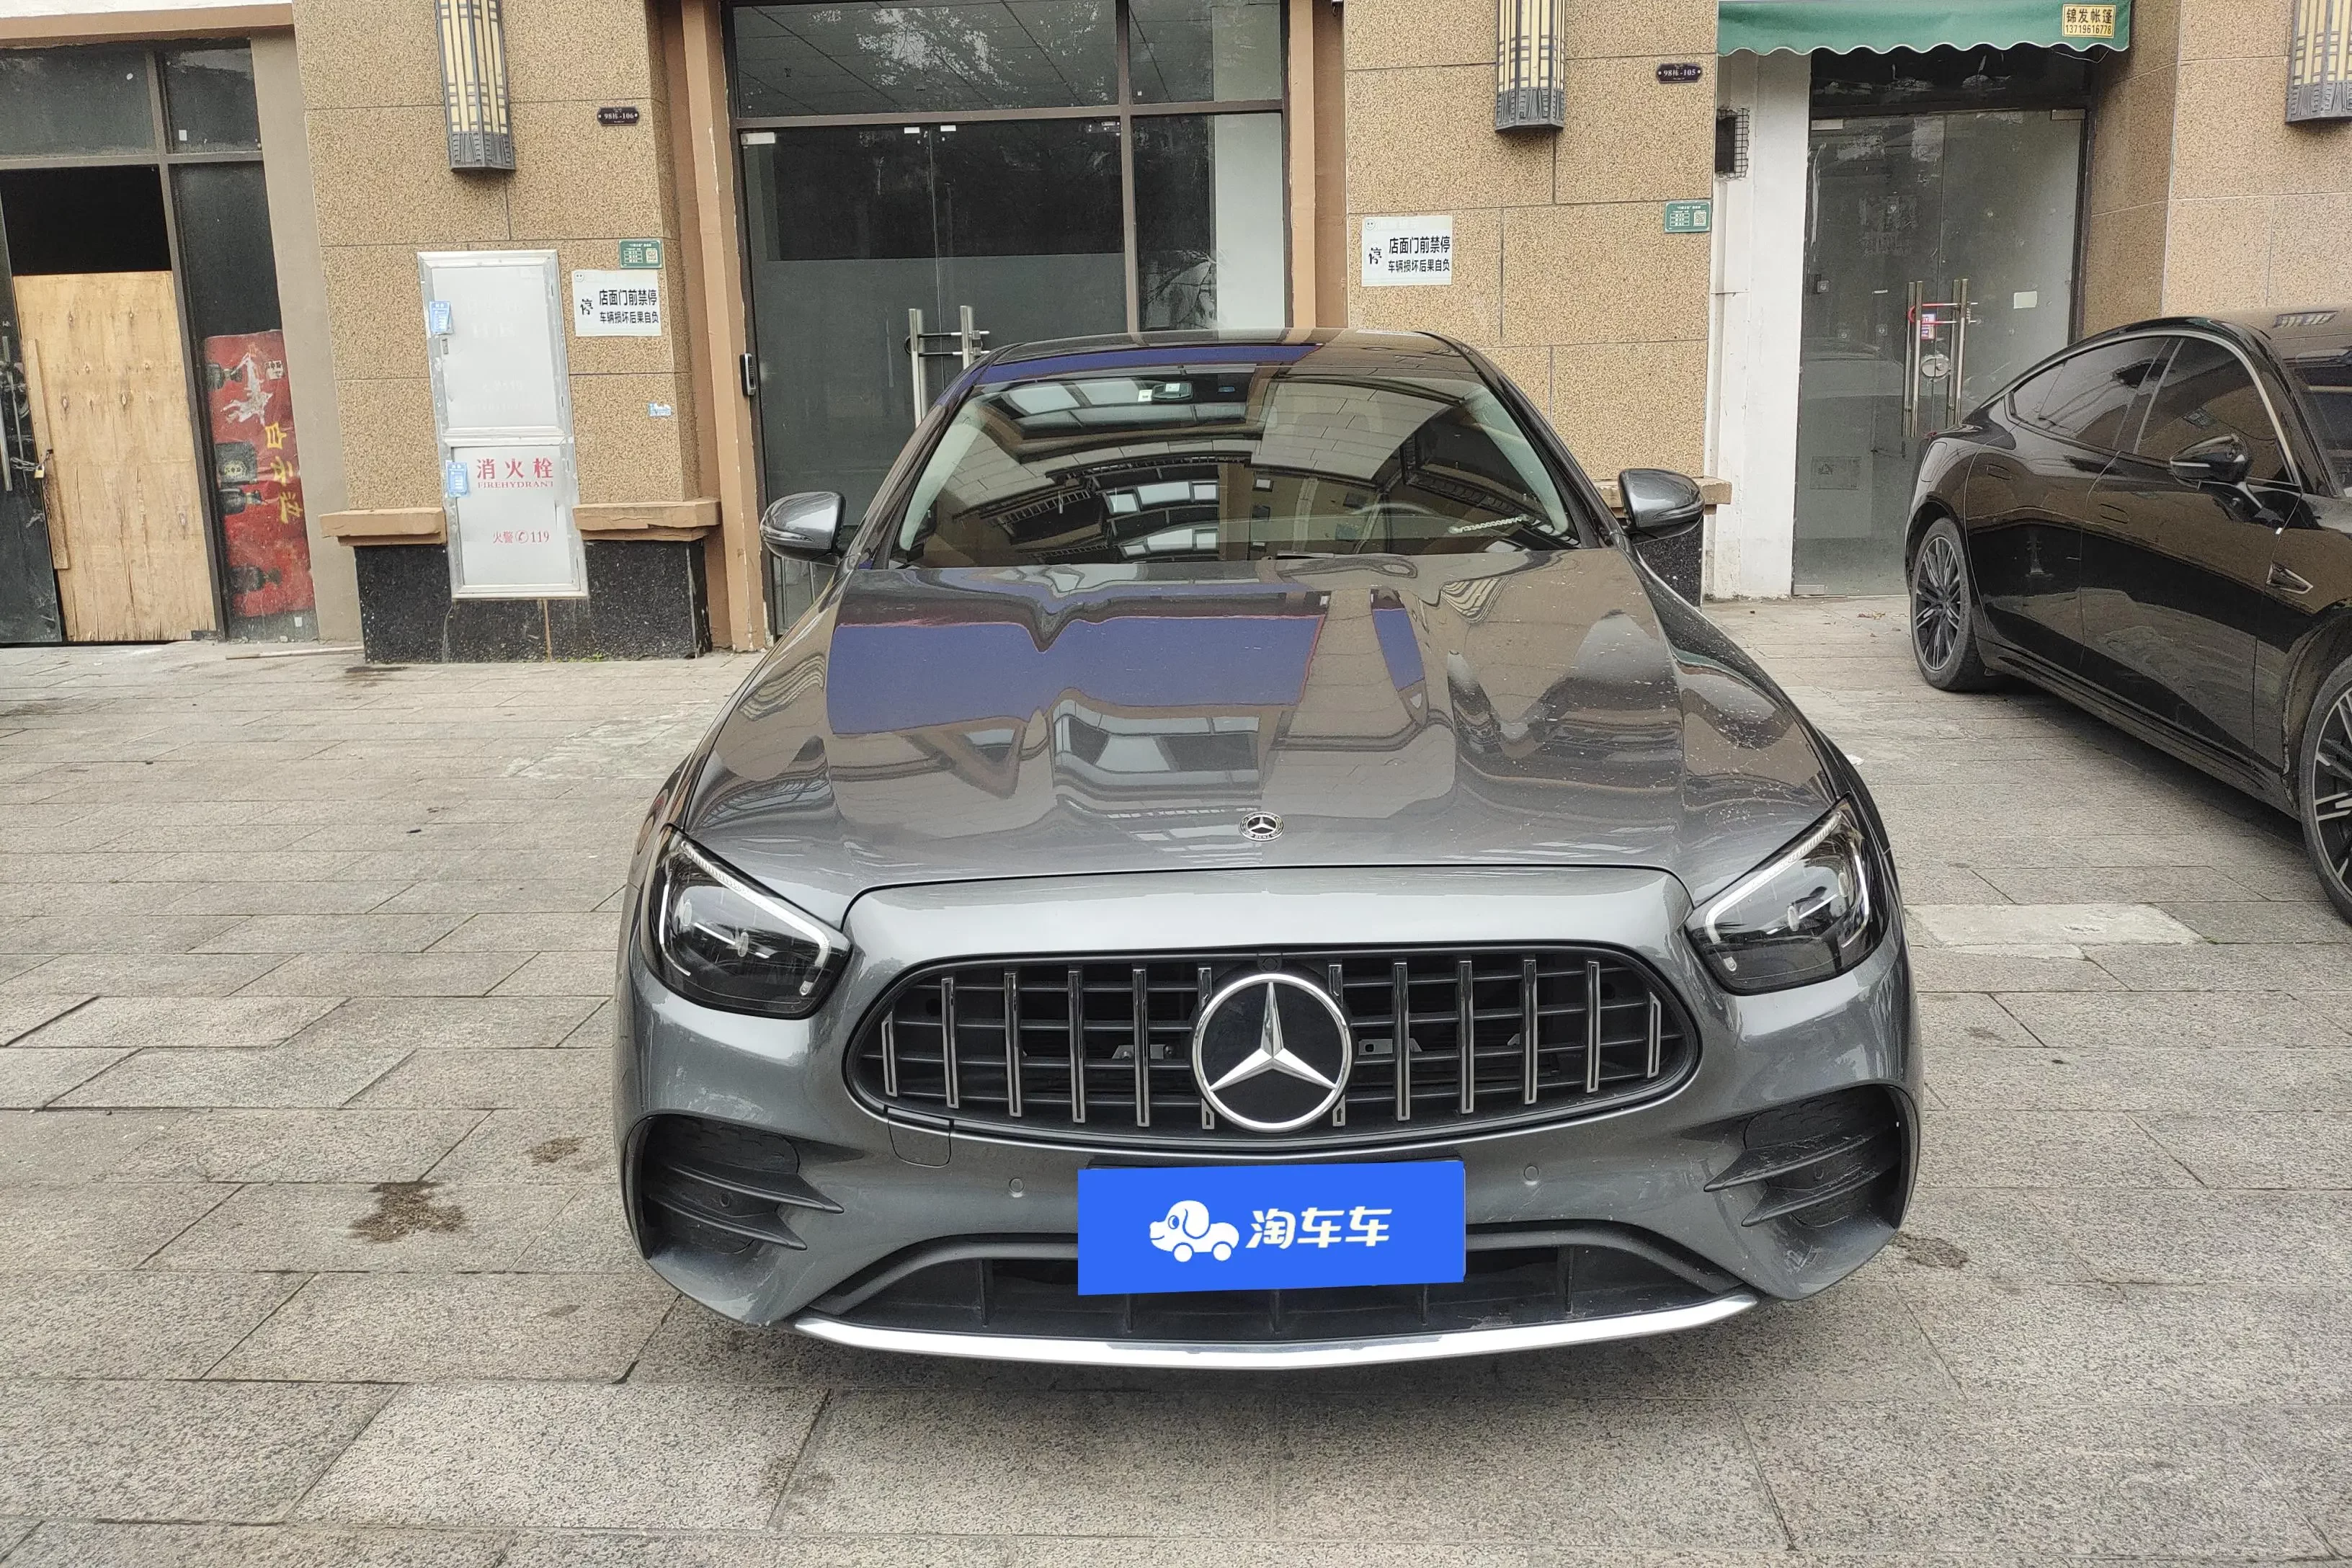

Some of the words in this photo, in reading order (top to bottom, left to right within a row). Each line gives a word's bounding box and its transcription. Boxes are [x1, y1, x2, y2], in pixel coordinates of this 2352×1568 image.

[2067, 8, 2113, 24] 锦发帐篷
[2065, 24, 2112, 35] 13719616778
[1389, 235, 1451, 254] 店面门前禁停
[1388, 258, 1451, 273] 车辆损坏后果自负
[599, 288, 657, 306] 店面门前禁停
[600, 311, 659, 324] 车辆损坏后果自负
[476, 458, 554, 480] 消火栓
[530, 530, 549, 543] 119
